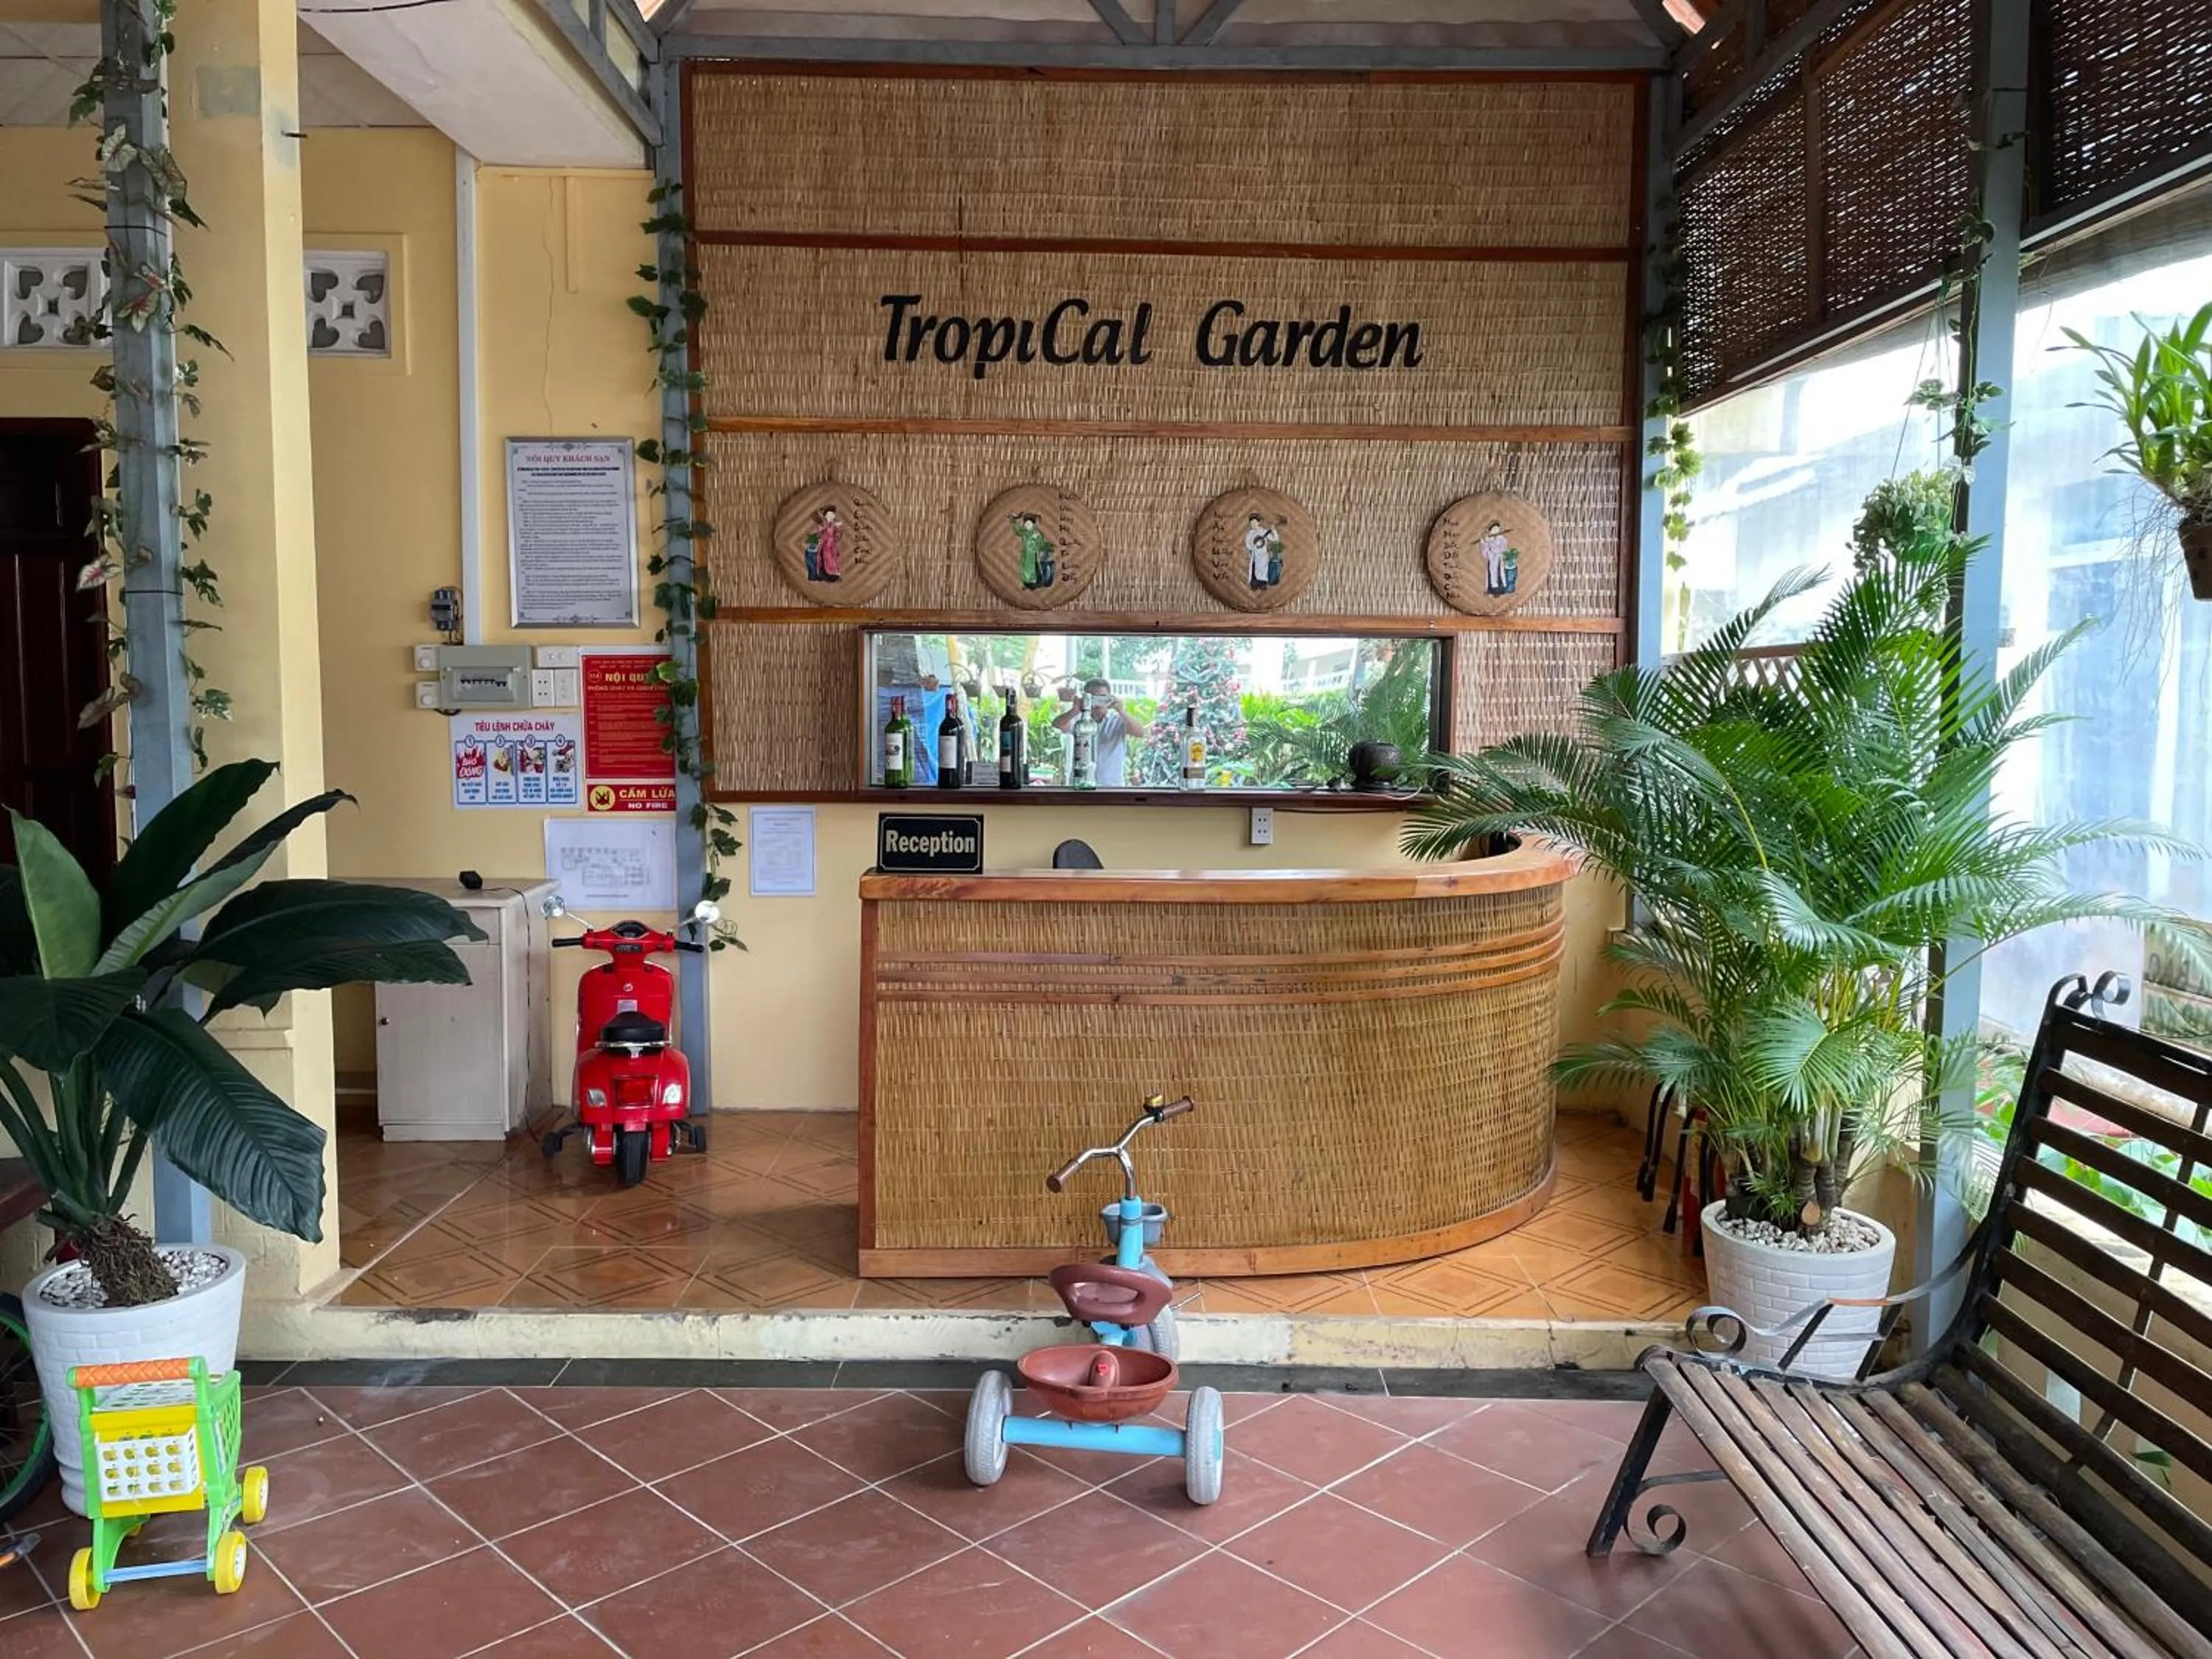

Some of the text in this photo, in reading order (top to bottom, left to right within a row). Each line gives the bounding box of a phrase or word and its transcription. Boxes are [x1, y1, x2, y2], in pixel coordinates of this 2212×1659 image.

[1197, 300, 1422, 368] Garden
[605, 672, 625, 684] NỘI
[619, 786, 647, 799] CẤM
[886, 830, 975, 857] Reception
